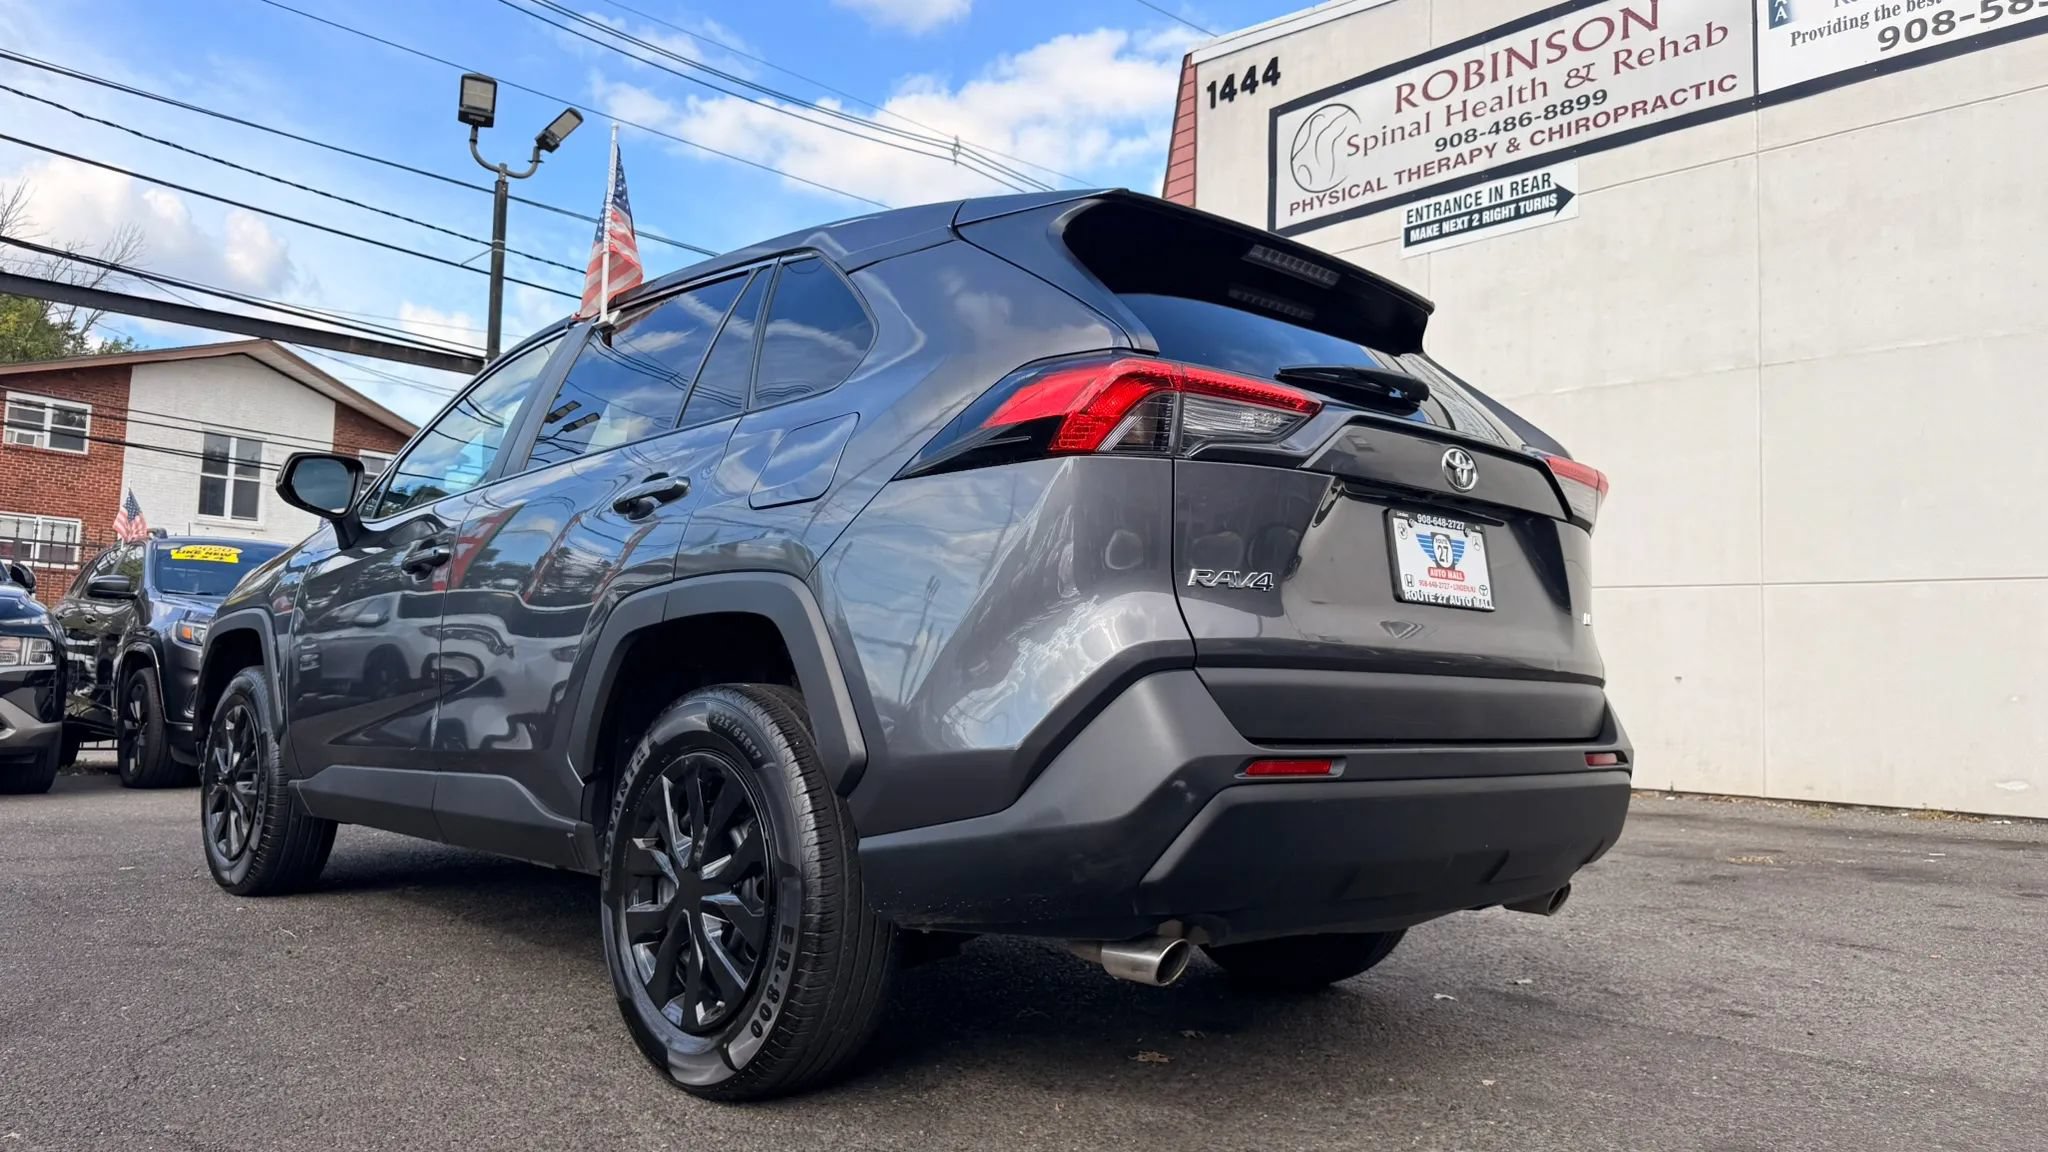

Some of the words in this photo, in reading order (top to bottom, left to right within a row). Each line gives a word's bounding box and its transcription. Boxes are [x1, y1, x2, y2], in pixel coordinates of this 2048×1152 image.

[1789, 12, 1870, 48] Providing
[1873, 4, 1901, 22] the
[1905, 0, 1942, 13] bes
[1877, 0, 2048, 51] 908-58
[1206, 55, 1281, 110] 1444
[1393, 0, 1659, 115] ROBINSON
[1346, 111, 1432, 157] Spinal
[1445, 76, 1549, 127] Health
[1564, 62, 1598, 90] &
[1612, 21, 1729, 75] Rehab
[1289, 176, 1389, 217] PHYSICAL
[1393, 141, 1498, 186] THERAPY
[1505, 136, 1521, 154] &
[1529, 73, 1738, 147] CHIROPRACTIC
[1434, 88, 1608, 152] 908-486-8899
[1406, 190, 1483, 225] ENTRANCE
[1488, 184, 1504, 203] IN
[1510, 172, 1552, 198] REAR
[1410, 223, 1441, 243] MAKE
[1442, 215, 1470, 235] NEXT
[1471, 213, 1480, 227] 2
[1482, 203, 1517, 225] RIGHT
[1518, 192, 1558, 216] TURNS
[1416, 513, 1465, 531] 908-648-2727
[1187, 568, 1275, 592] RAV4
[1430, 568, 1447, 578] AUTO
[1447, 570, 1464, 580] MALL
[1437, 545, 1450, 564] 27
[1405, 590, 1437, 602] ROUTE
[1437, 593, 1448, 604] 27
[1449, 595, 1472, 607] AUTO
[1473, 598, 1495, 610] MALL
[712, 712, 762, 760] 225/65R17
[750, 924, 795, 1039] ER-800
